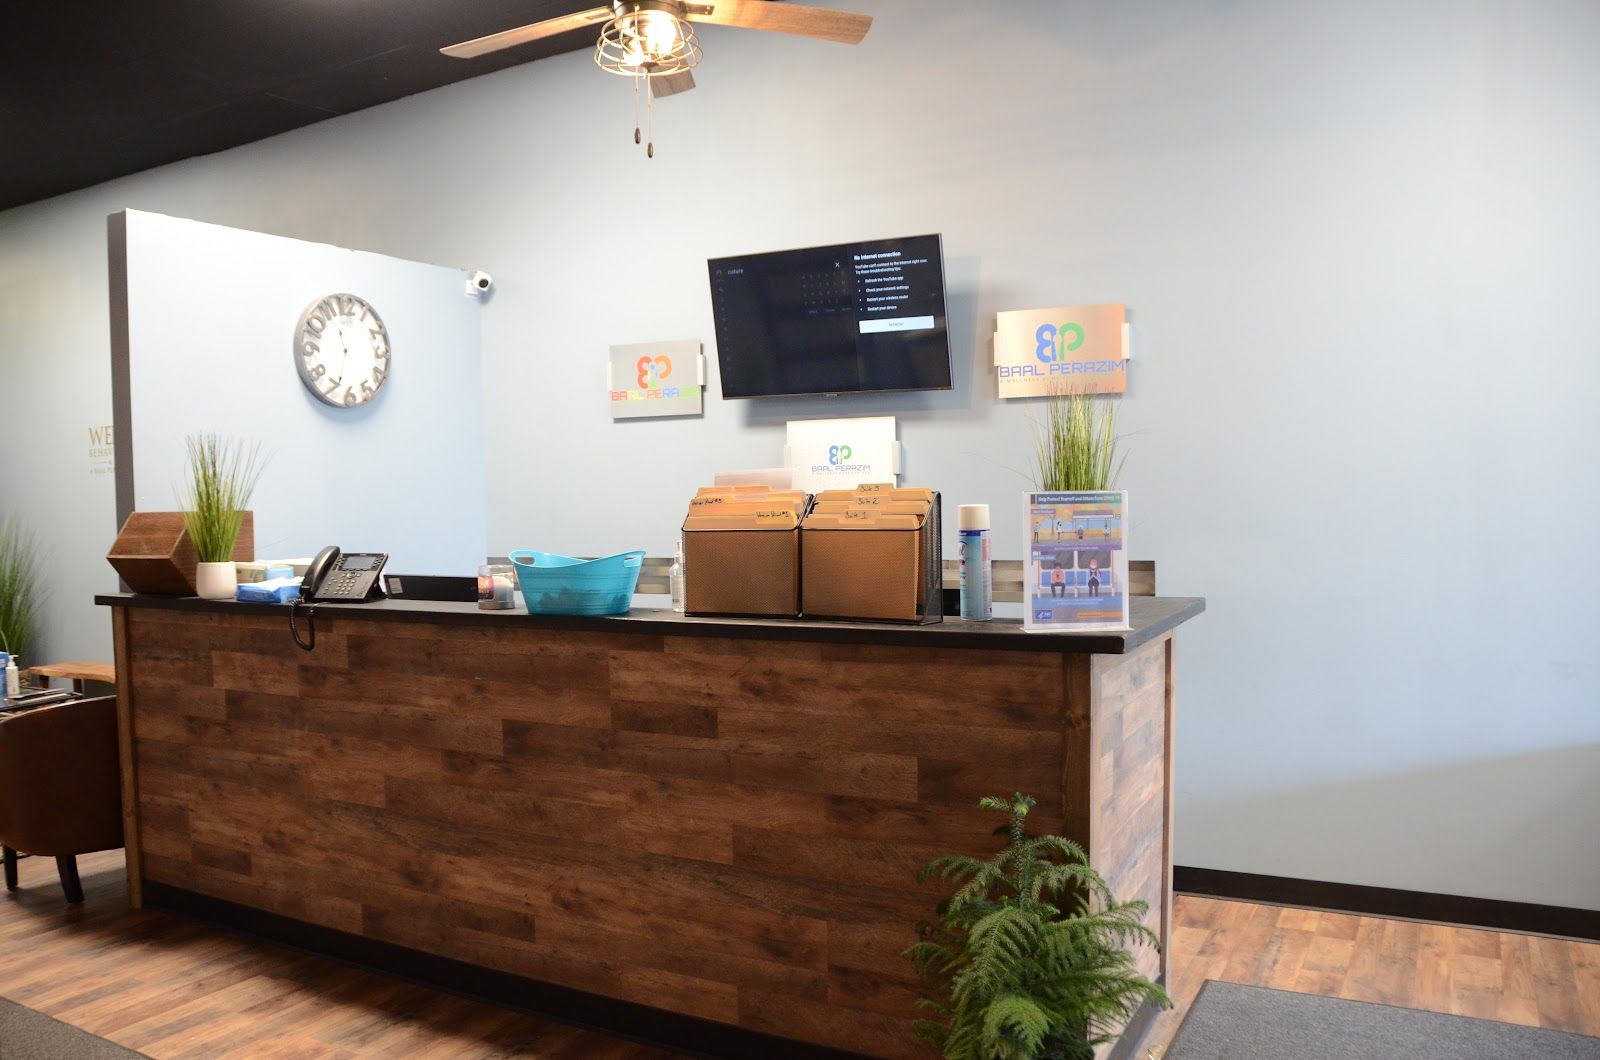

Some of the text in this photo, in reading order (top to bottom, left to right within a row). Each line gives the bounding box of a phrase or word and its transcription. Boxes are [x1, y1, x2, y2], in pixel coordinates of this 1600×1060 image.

[302, 315, 326, 340] 10
[302, 341, 320, 356] 9
[374, 346, 390, 360] 3
[309, 364, 326, 382] 8
[372, 366, 388, 384] 4
[1000, 360, 1125, 378] BAAL PERAZIM
[324, 378, 342, 396] 7
[344, 386, 356, 406] 6
[360, 379, 374, 402] 5
